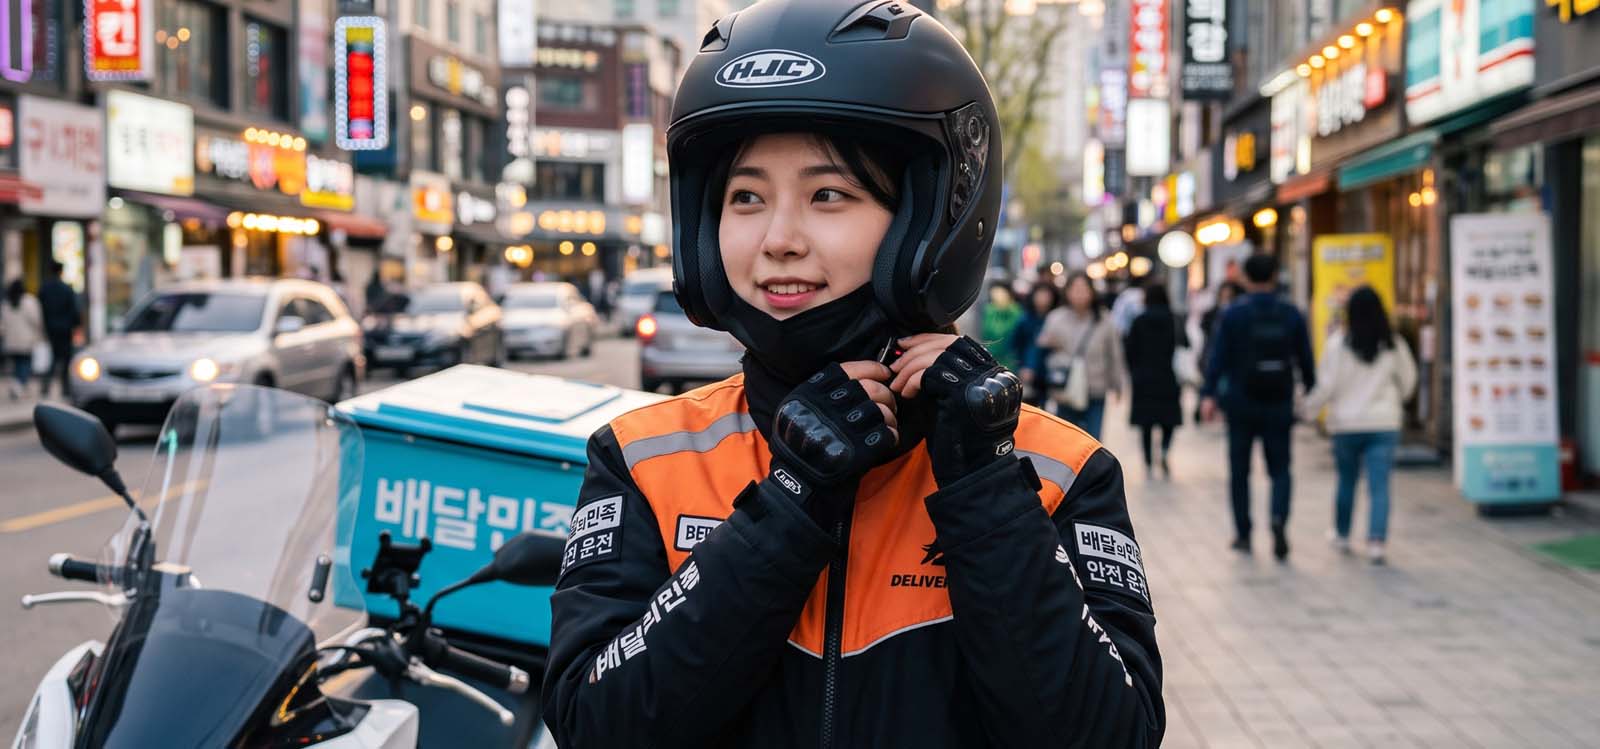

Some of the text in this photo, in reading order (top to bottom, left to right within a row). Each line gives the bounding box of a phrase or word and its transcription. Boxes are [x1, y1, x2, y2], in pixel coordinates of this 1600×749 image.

[728, 60, 809, 80] HJC
[580, 532, 614, 560] 운전
[1086, 560, 1125, 588] 안전
